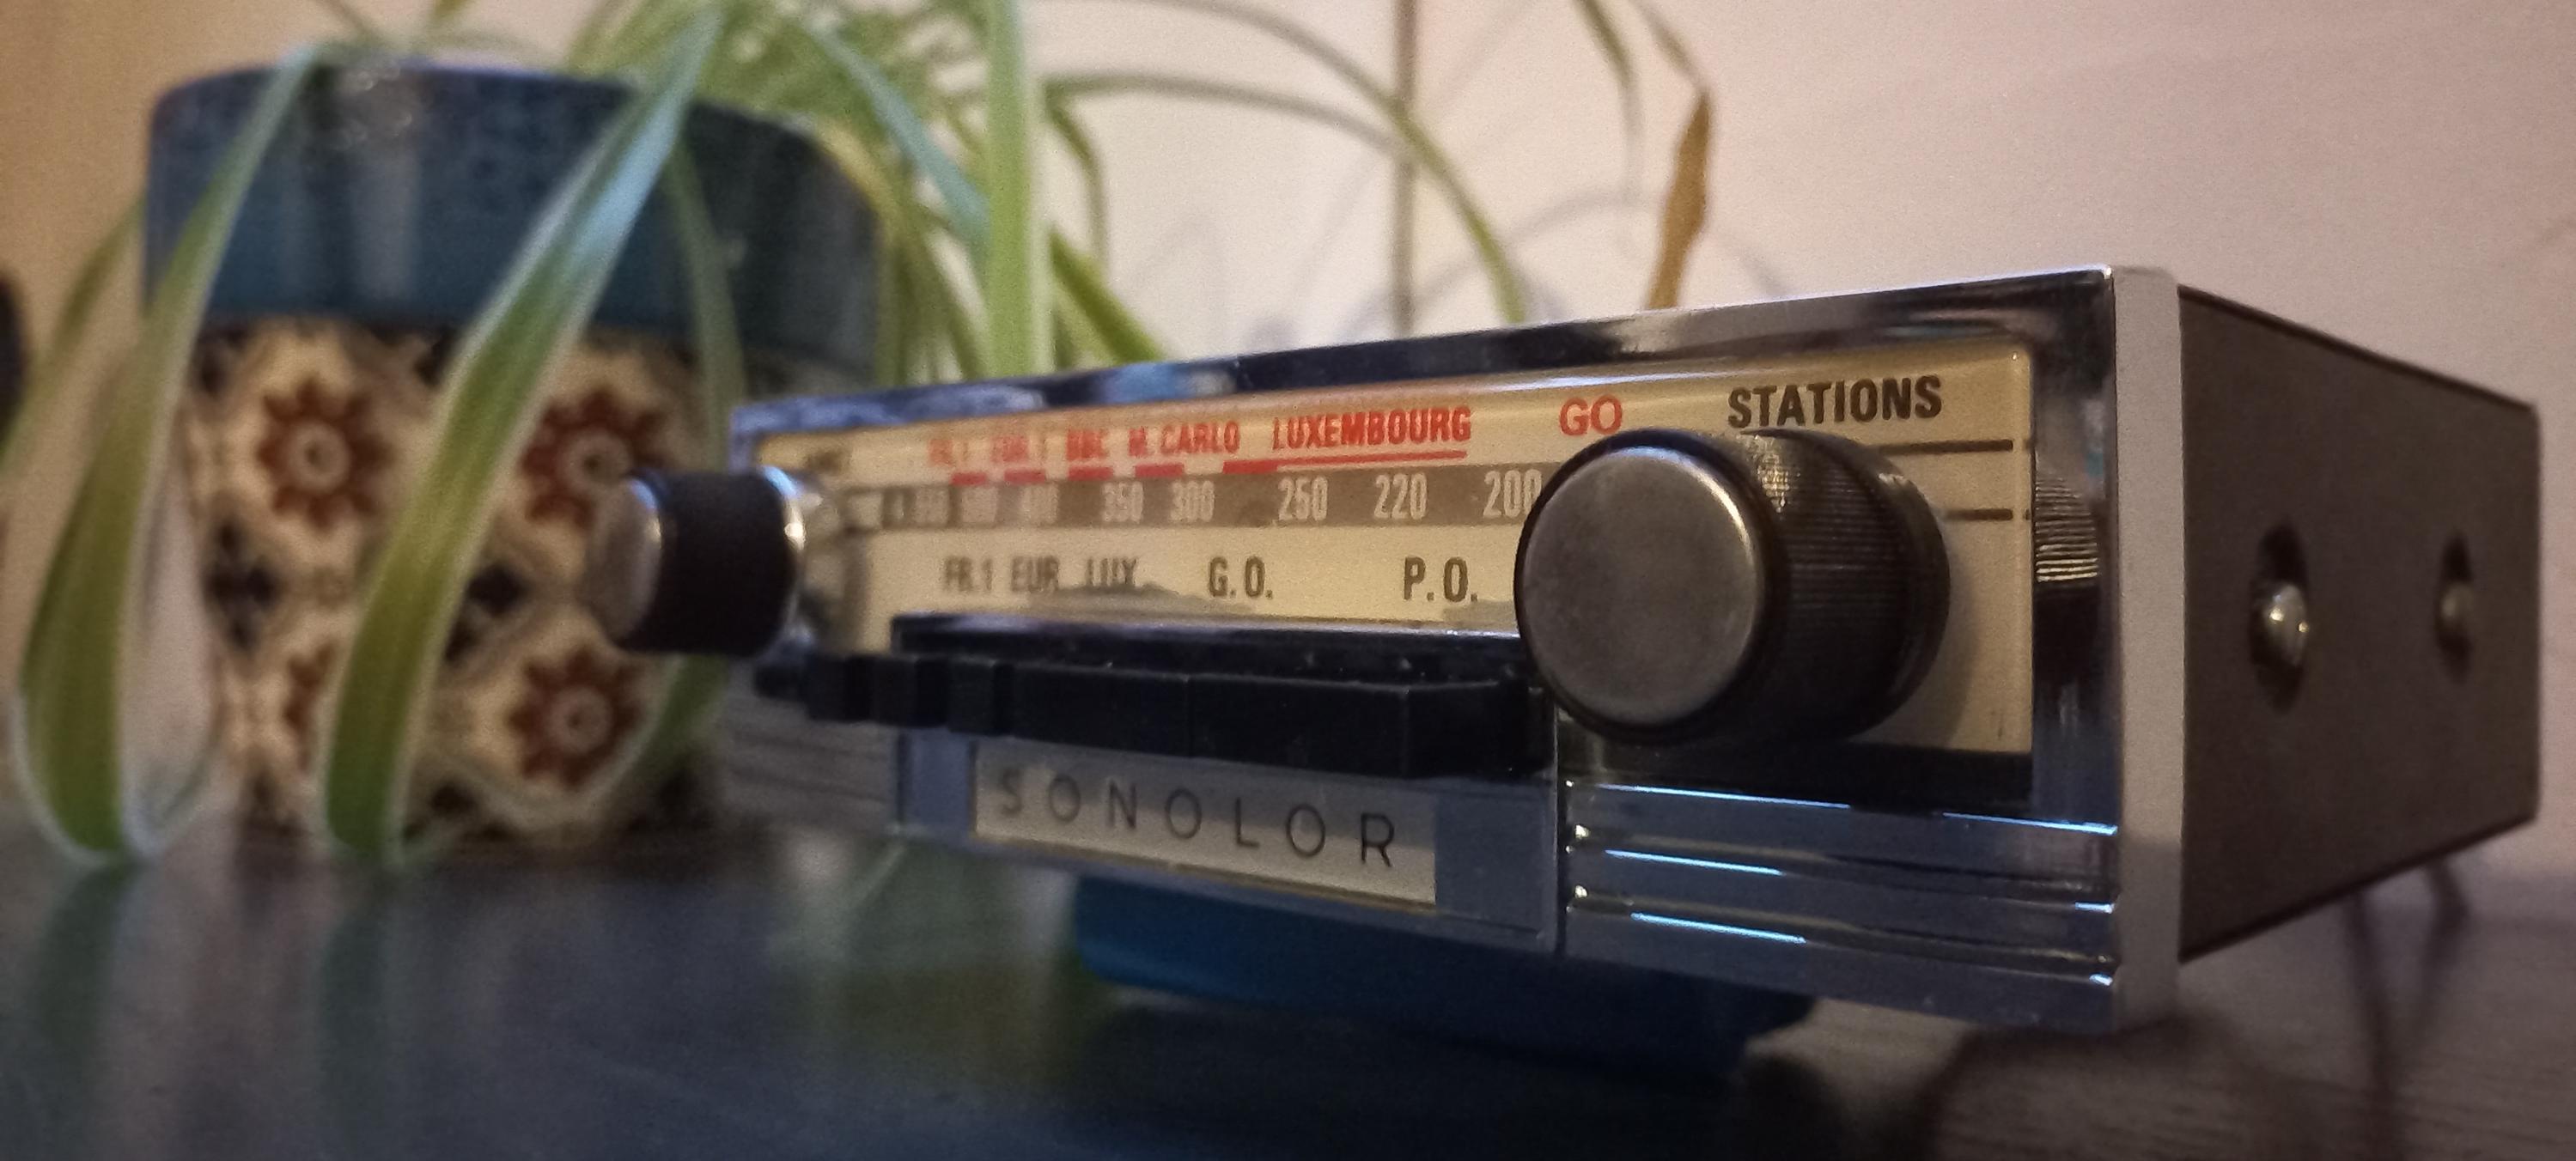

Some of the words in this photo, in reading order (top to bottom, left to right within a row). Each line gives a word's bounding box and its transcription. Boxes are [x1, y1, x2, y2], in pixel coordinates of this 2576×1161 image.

[1160, 421, 1241, 454] CARLO
[1272, 405, 1471, 451] LUXEMBOURG
[1559, 395, 1623, 436] GO
[1728, 375, 1943, 429] STATIONS
[1101, 481, 1145, 524] 350
[1170, 478, 1215, 522] 300
[1277, 475, 1330, 520] 250
[1375, 471, 1428, 519] 220
[1483, 468, 1543, 518] 200
[1010, 555, 1061, 593] EUR
[1209, 556, 1273, 599] G.O.
[1404, 556, 1477, 602] P.O.
[1000, 767, 1397, 868] SONOLOR
